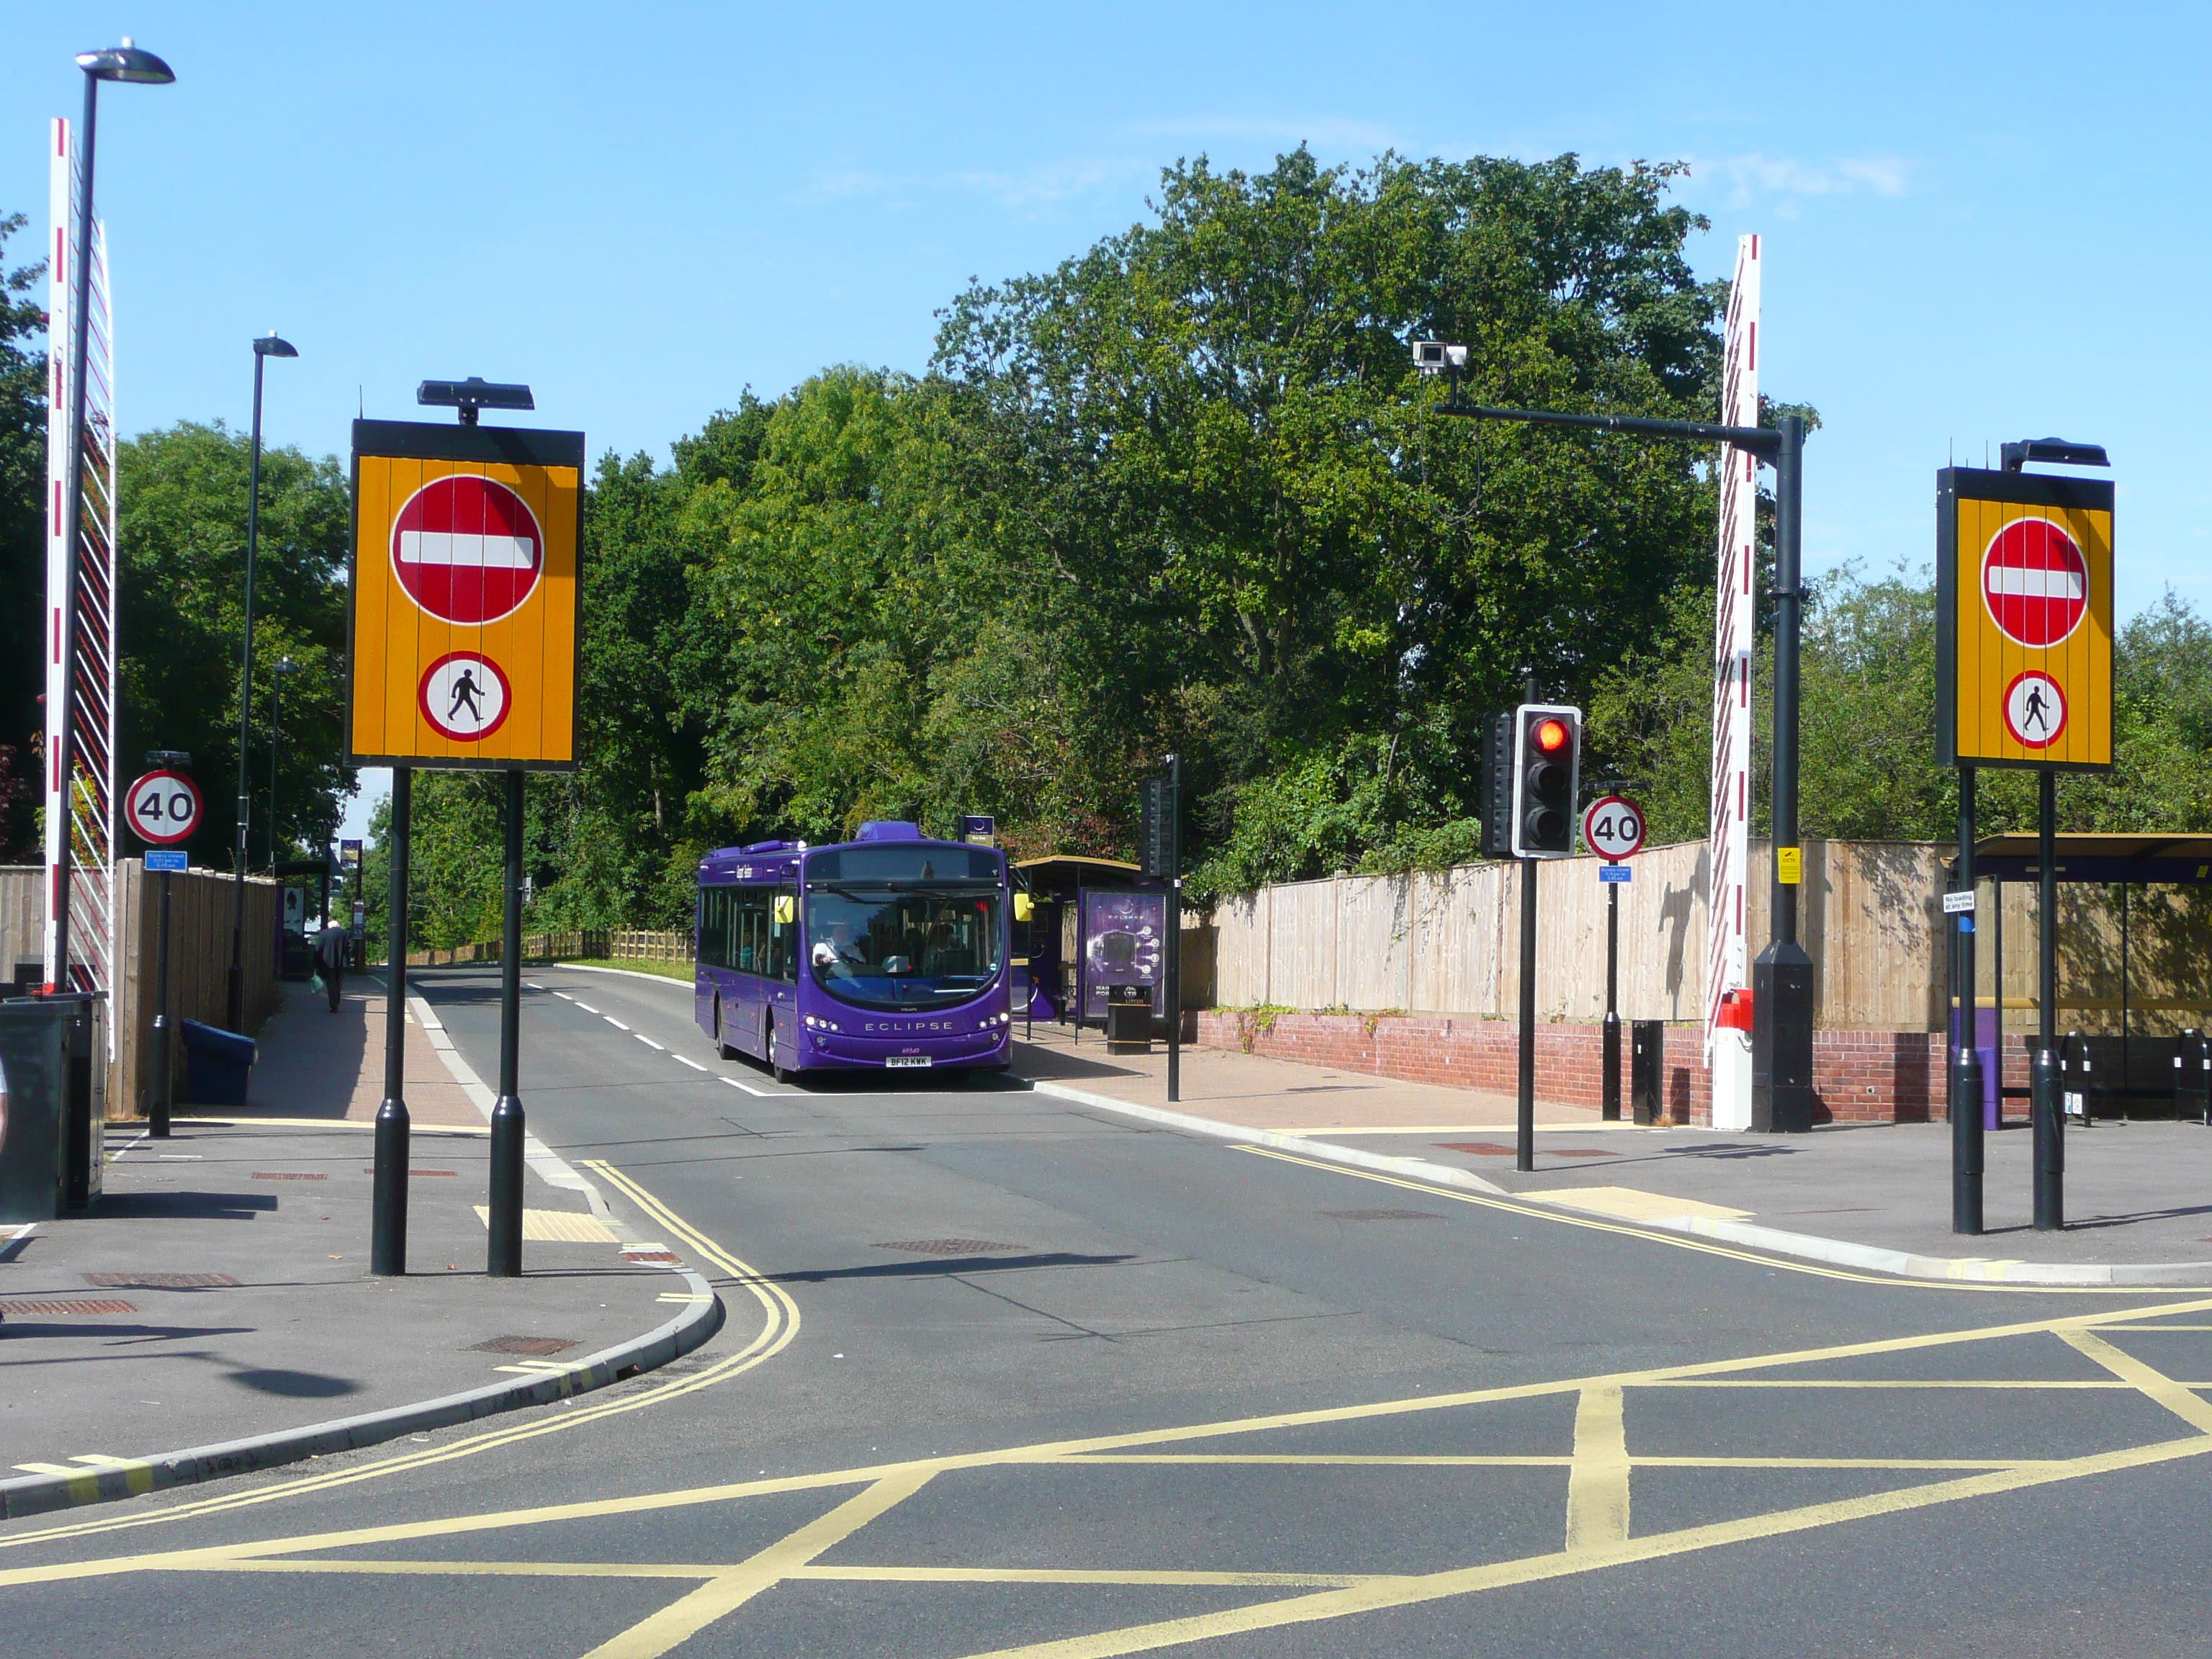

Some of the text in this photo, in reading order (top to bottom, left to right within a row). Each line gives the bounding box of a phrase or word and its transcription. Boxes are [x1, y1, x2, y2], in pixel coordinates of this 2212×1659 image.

[138, 793, 192, 822] 40
[1594, 816, 1638, 842] 40
[865, 1022, 953, 1031] ECLIPSE
